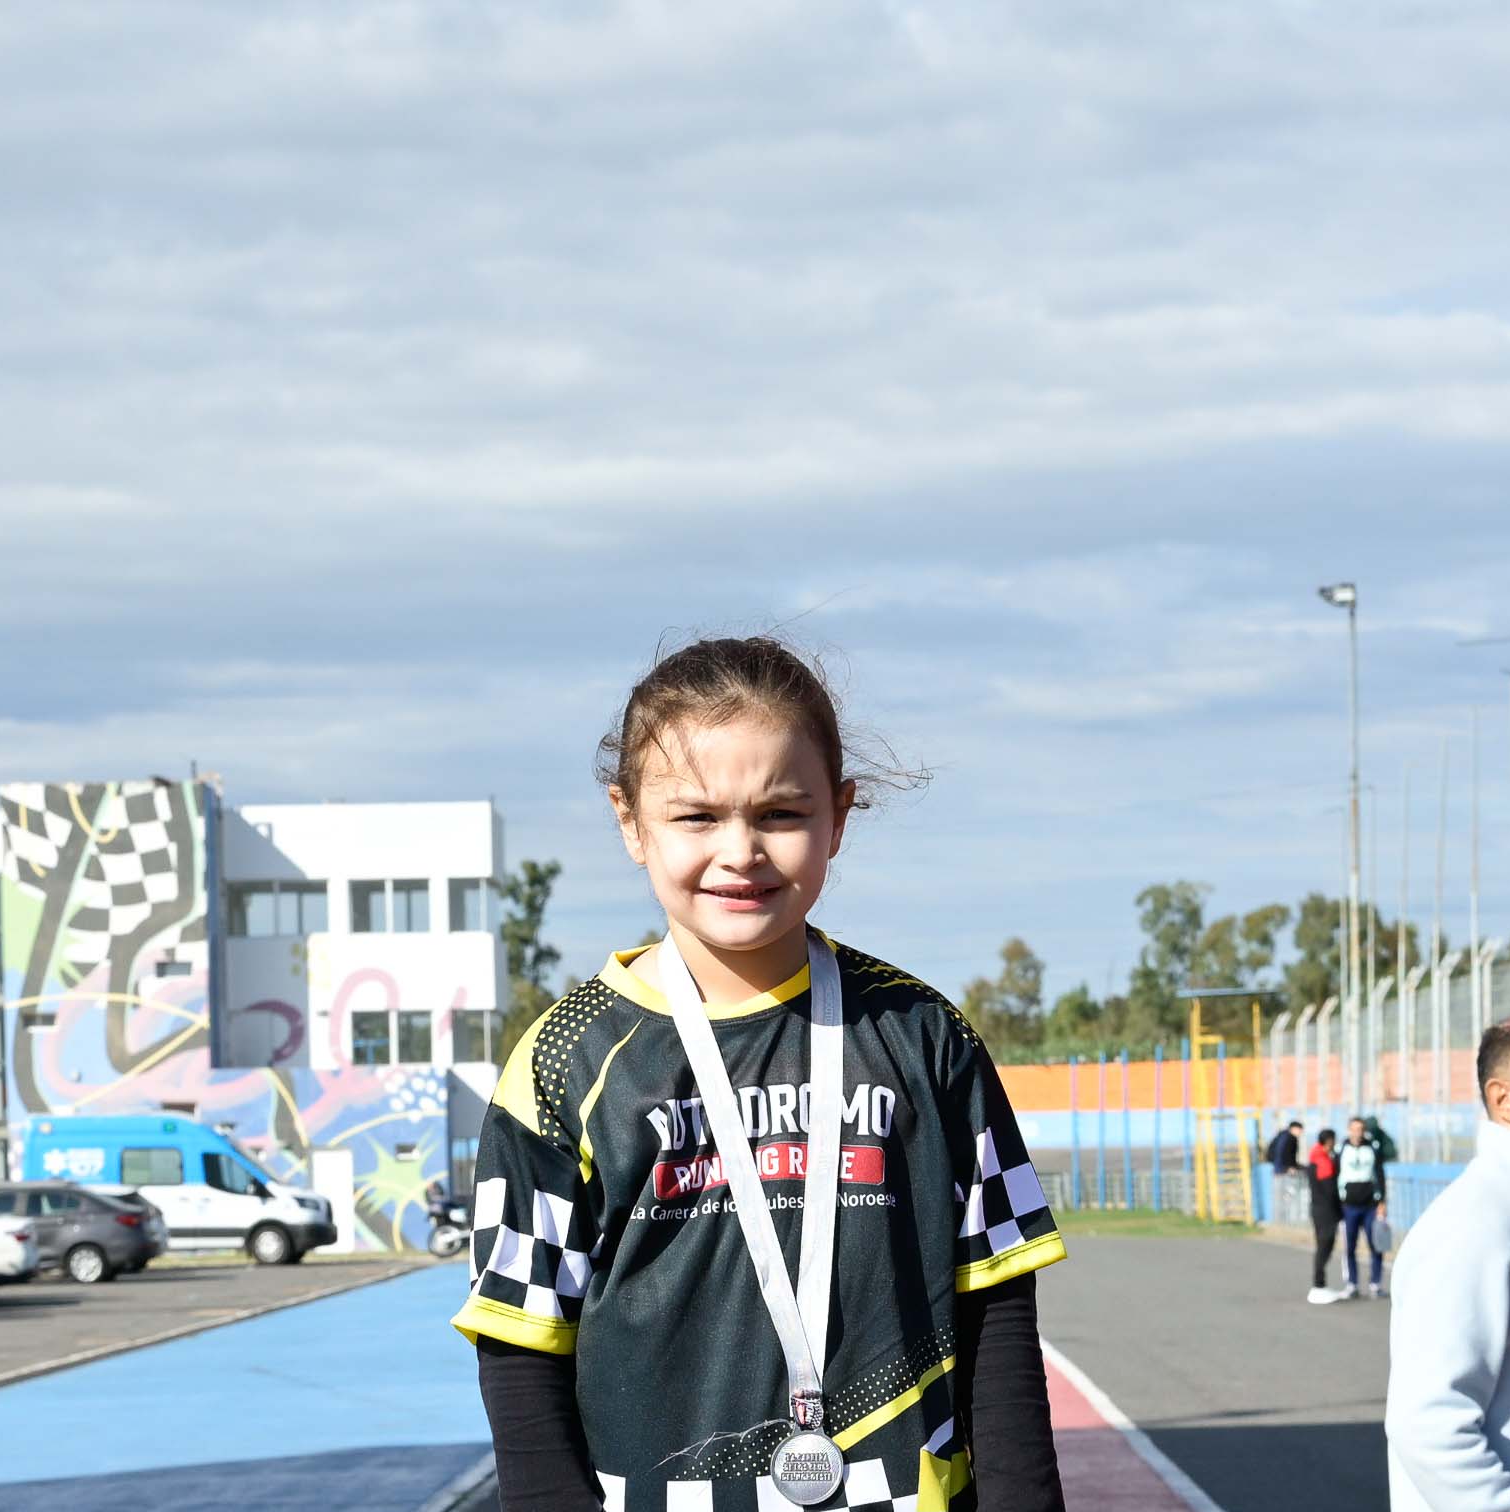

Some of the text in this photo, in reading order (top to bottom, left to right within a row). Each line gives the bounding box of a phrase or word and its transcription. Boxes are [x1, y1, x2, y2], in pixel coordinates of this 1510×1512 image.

[646, 1083, 896, 1151] AUTDRMO
[674, 1146, 855, 1193] RUNG RE
[630, 1206, 646, 1221] La
[651, 1203, 698, 1221] Carrera
[701, 1197, 720, 1214] de
[724, 1197, 738, 1213] lo
[768, 1193, 804, 1210] ubes
